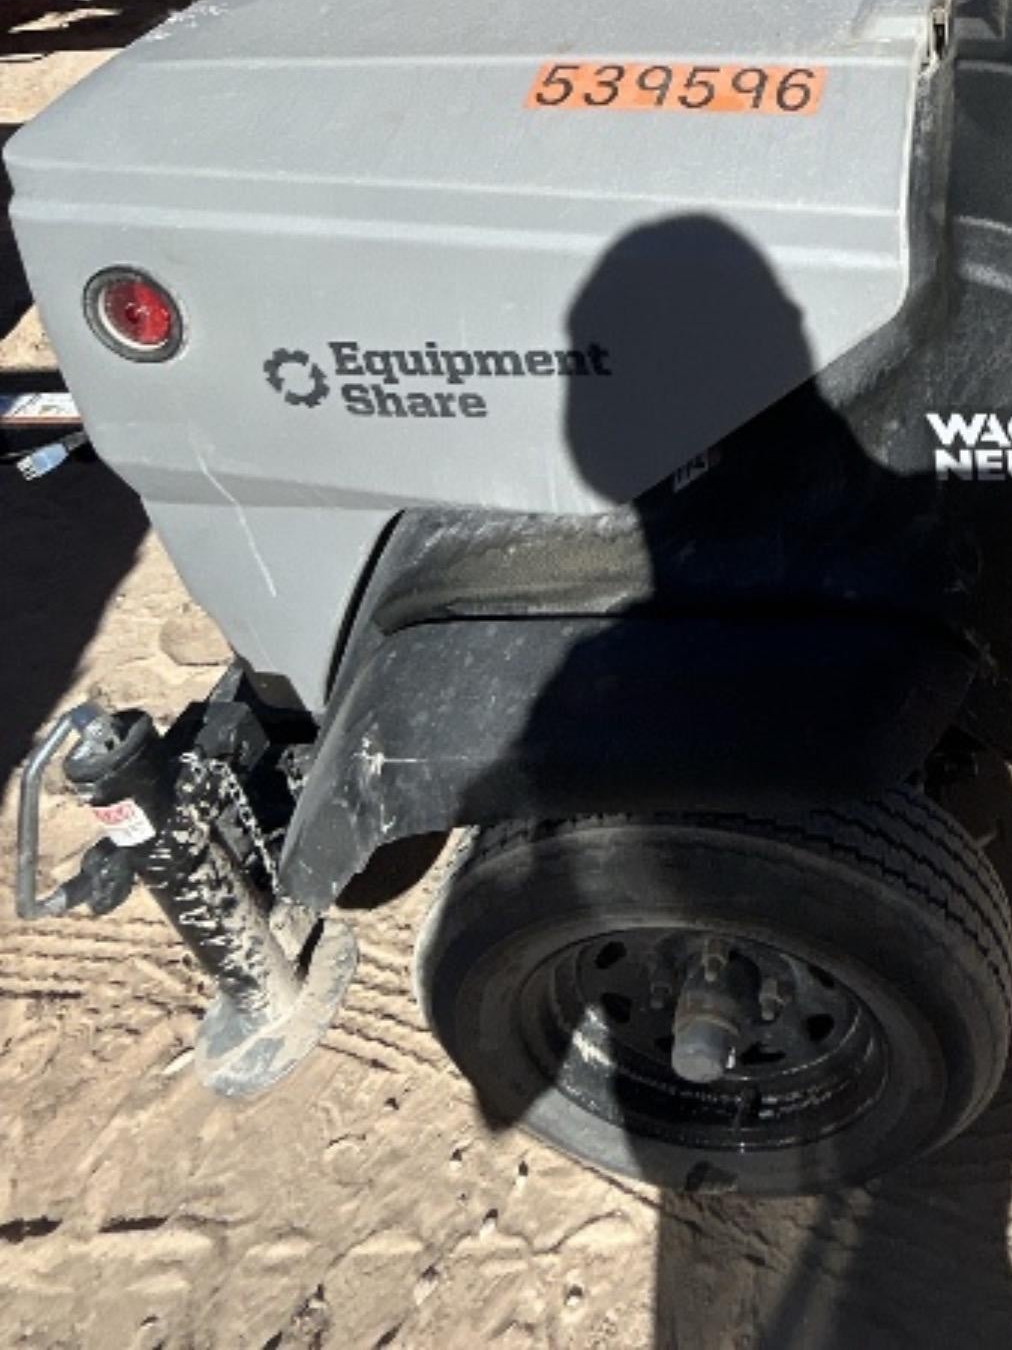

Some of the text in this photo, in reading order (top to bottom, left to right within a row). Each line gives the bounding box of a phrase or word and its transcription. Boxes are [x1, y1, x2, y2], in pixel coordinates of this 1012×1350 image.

[535, 64, 815, 111] 539596
[327, 341, 612, 384] Equipment
[341, 383, 488, 417] Share
